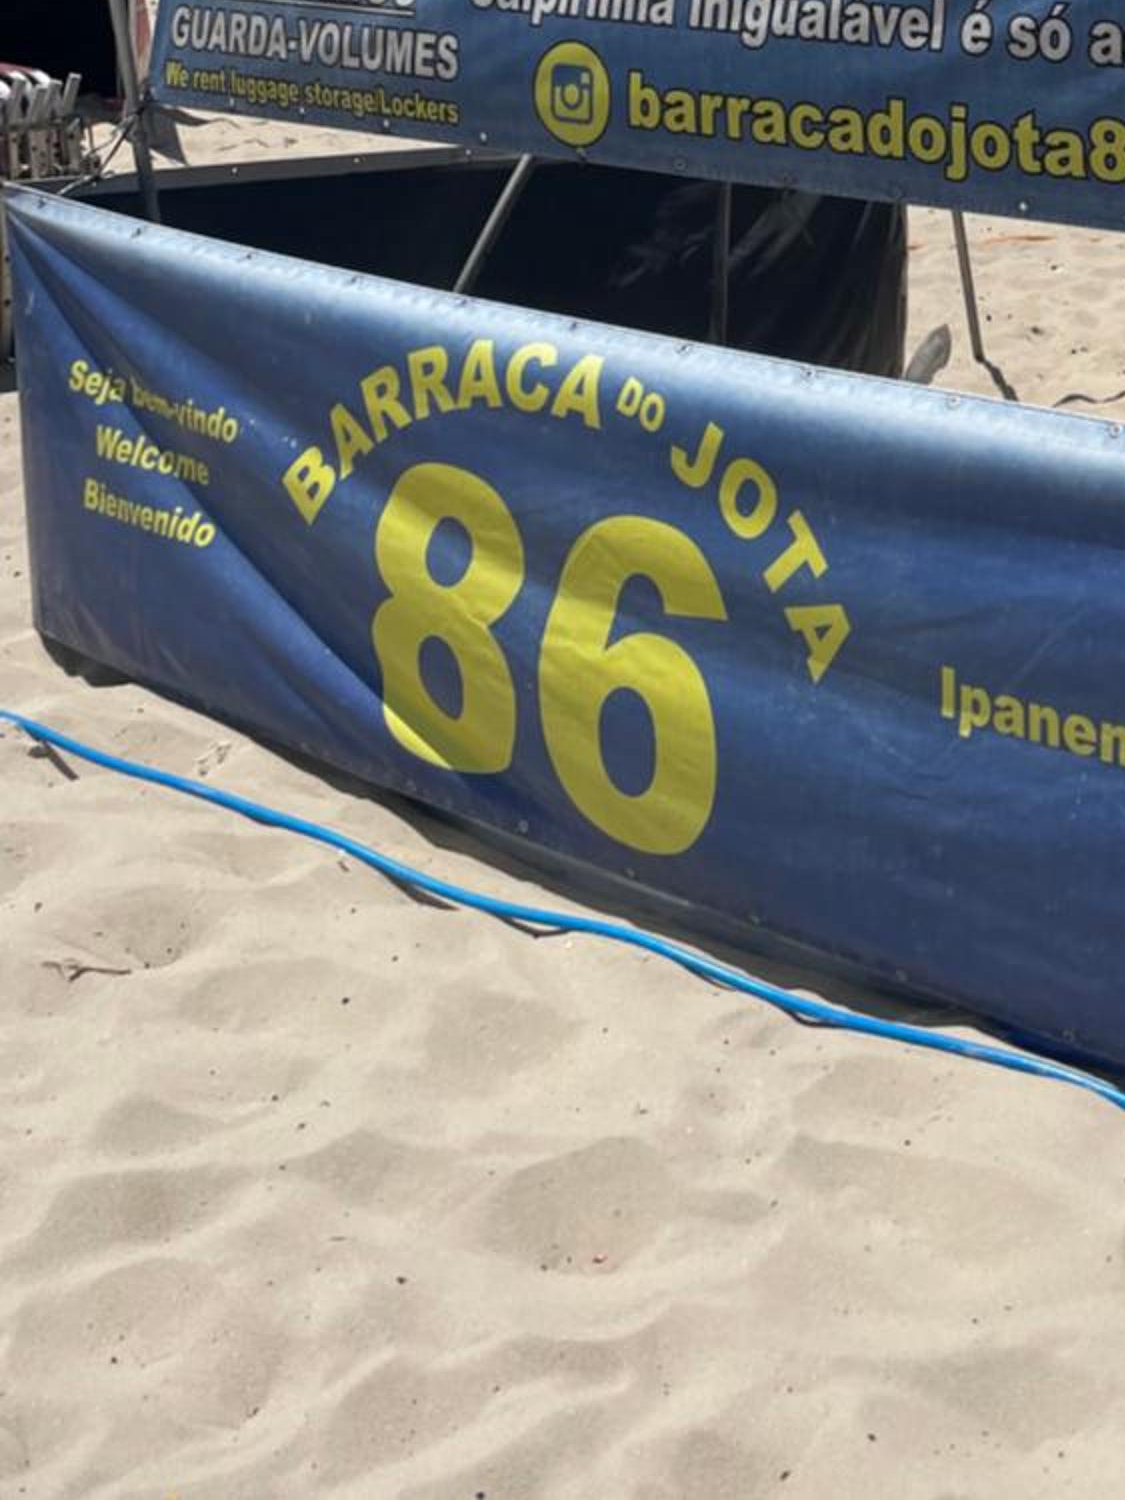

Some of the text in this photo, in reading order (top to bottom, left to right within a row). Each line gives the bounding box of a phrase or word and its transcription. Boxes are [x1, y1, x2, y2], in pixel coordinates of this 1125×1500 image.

[169, 7, 460, 80] GUARDA-VOLUMES
[960, 0, 992, 53] é
[1007, 6, 1073, 61] só
[165, 61, 189, 88] We
[192, 69, 226, 92] rent
[229, 70, 300, 107] luggage
[69, 359, 126, 405] Seja
[96, 424, 209, 485] Welcome
[83, 477, 216, 546] Bienvenido
[281, 338, 851, 684] BARRACA DO JOTA
[371, 462, 727, 856] 86
